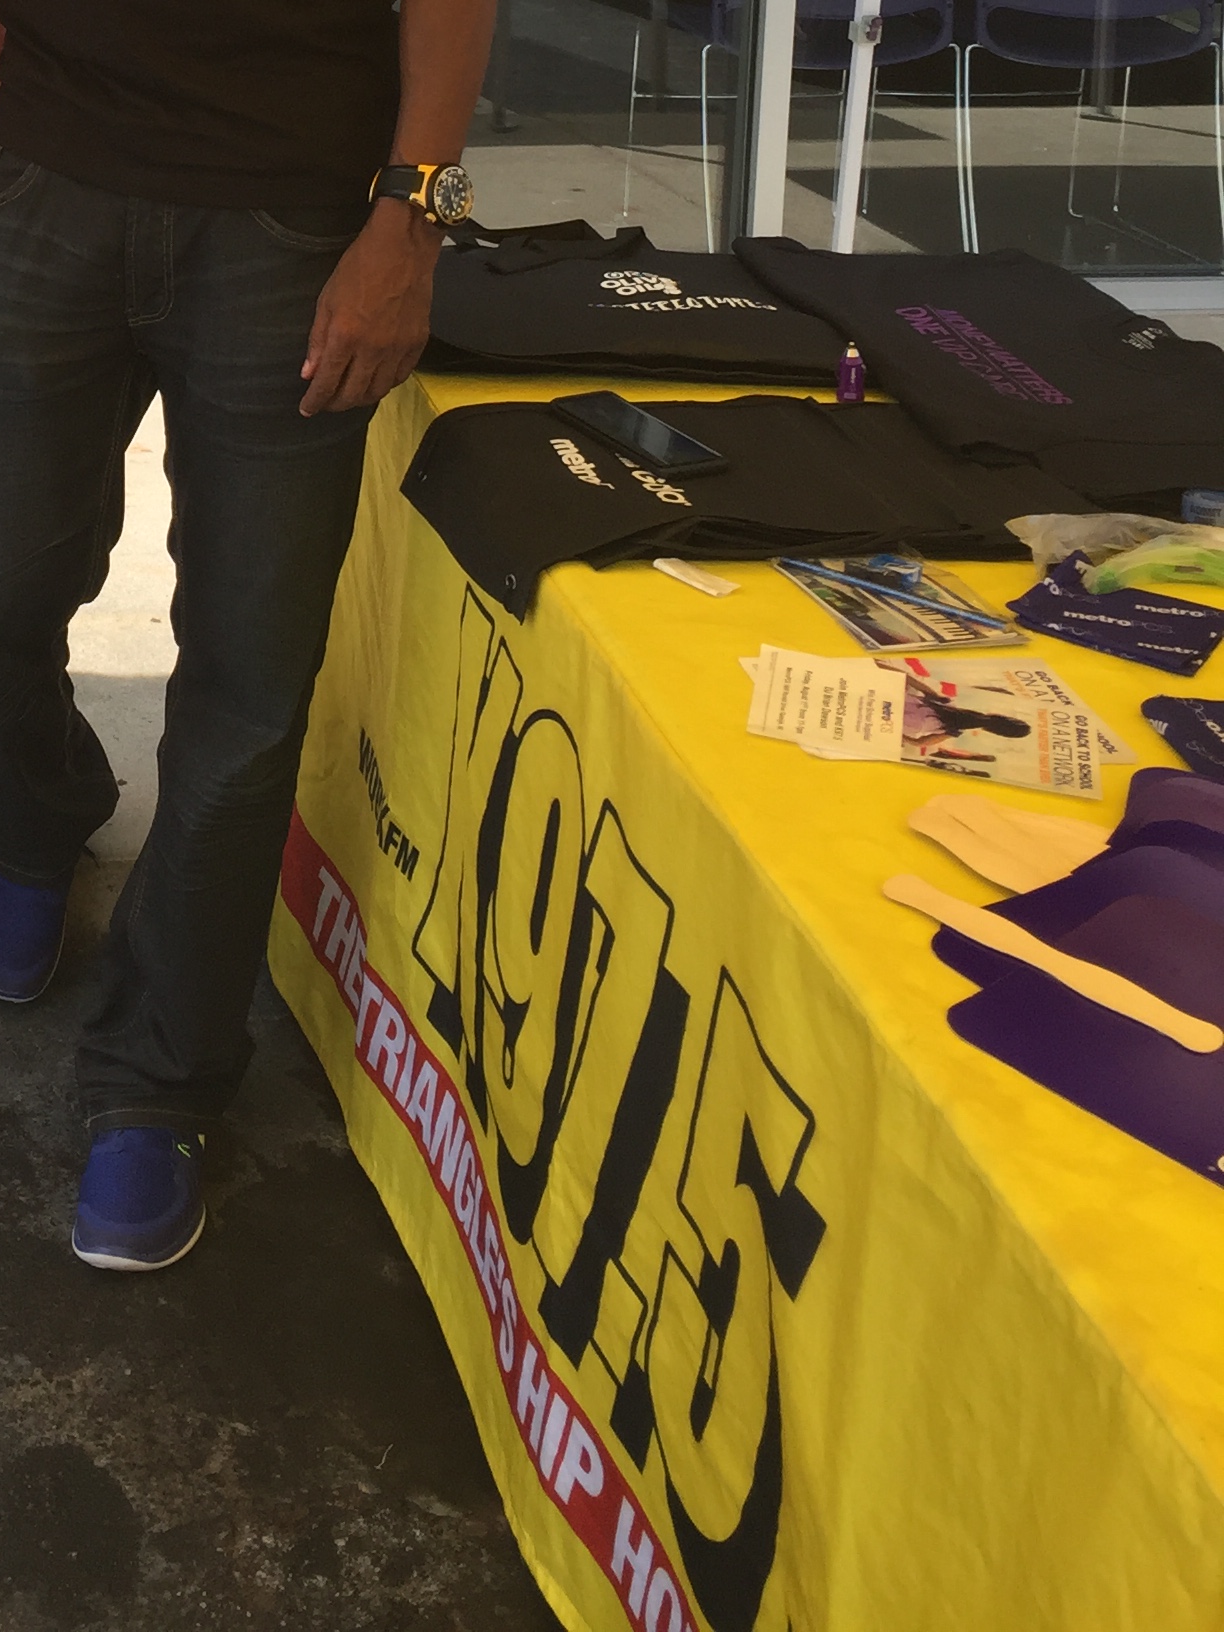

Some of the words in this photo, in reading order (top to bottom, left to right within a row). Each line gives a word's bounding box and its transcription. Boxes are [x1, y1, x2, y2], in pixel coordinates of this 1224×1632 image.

[1015, 671, 1038, 687] ON
[1031, 689, 1048, 697] A
[1051, 711, 1071, 728] ON
[1074, 715, 1088, 726] GO
[1052, 728, 1071, 736] A
[1076, 728, 1090, 748] BACK
[1052, 737, 1074, 786] NETWORK
[1077, 751, 1090, 761] TO
[1078, 762, 1092, 790] SCHOOL
[517, 1339, 604, 1505] HIP
[611, 1495, 688, 1632] HO
